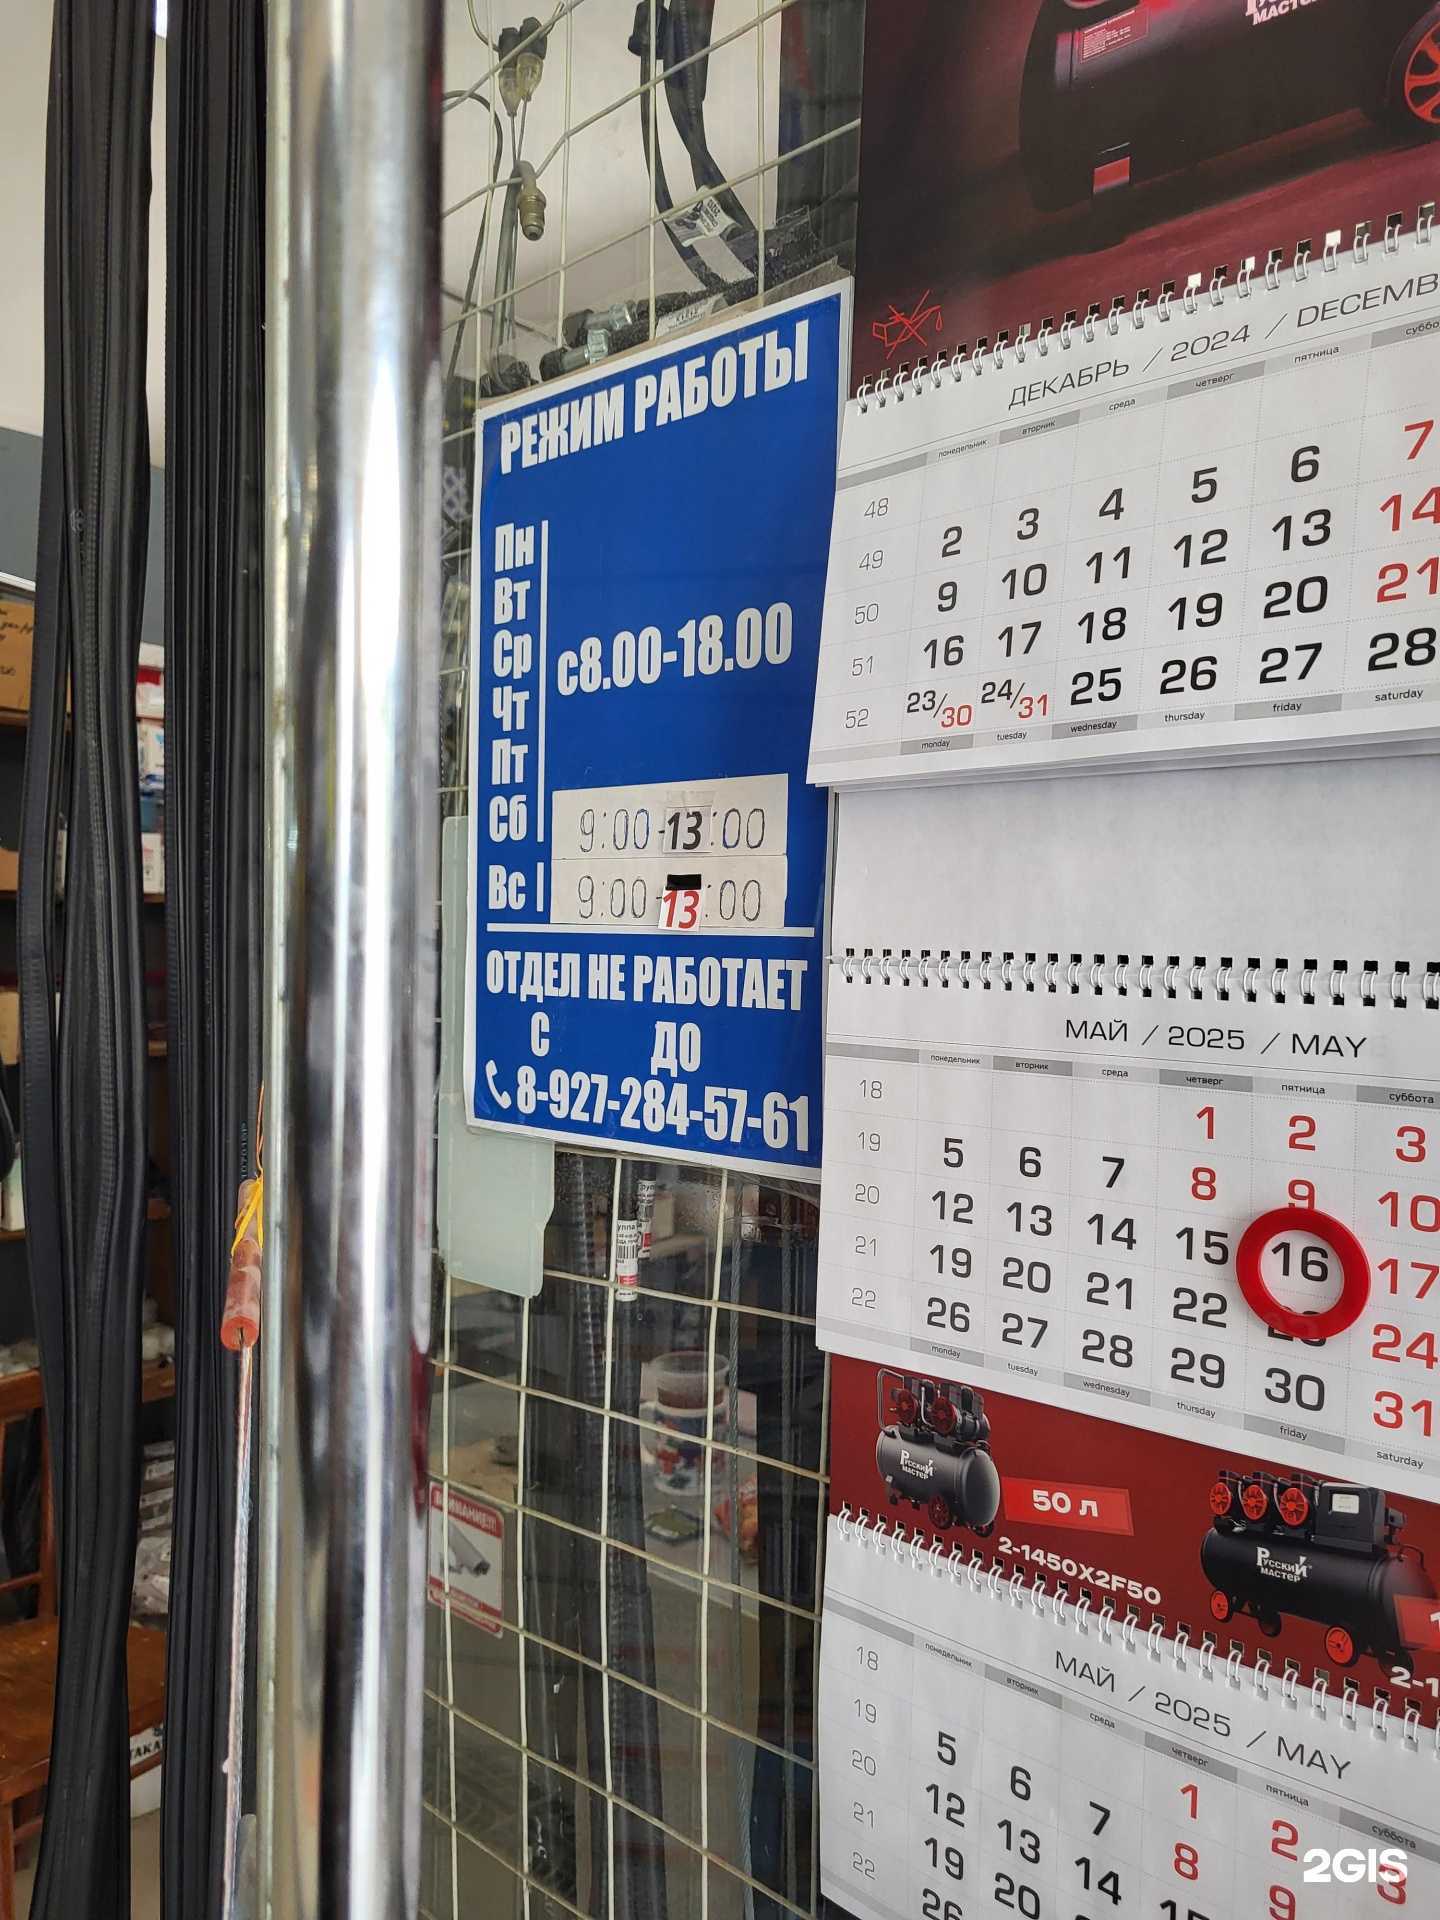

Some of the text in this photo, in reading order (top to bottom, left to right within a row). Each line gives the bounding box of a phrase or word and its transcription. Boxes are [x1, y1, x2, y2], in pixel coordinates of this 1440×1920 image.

[1007, 273, 1440, 411] ДЕКАБРЬ 2024 DECEMB
[501, 320, 808, 475] РЕЖИМ РАБОТЫ
[939, 440, 987, 458] понедельник
[1022, 420, 1055, 434] вторник
[1109, 399, 1135, 410] среда
[1196, 373, 1234, 387] четверг
[1295, 347, 1339, 363] пятница
[859, 420, 1433, 570] 49 2 3 4 5 6 7
[864, 498, 888, 518] 48
[495, 523, 534, 572] Пн
[855, 487, 1440, 624] 50 9 10 11 12 13 14
[494, 578, 530, 624] Вт
[852, 557, 1439, 676] 51 16 17 18 19 20 21
[494, 630, 531, 679] Ср
[558, 603, 792, 695] с8.00-18.00
[846, 628, 1436, 728] 52 23/30 24/31 25 26 27 28
[493, 686, 529, 731] Чт
[922, 690, 1423, 752] monday tuesday wednesday thursday friday saturday
[492, 739, 528, 785] Пт
[490, 795, 527, 842] Сб
[489, 865, 525, 909] Вс
[487, 950, 807, 1010] ОТДЕЛ НЕ РАБОТАЕТ
[531, 1012, 700, 1077] С ДО
[931, 1055, 980, 1064] понедельник
[1016, 1062, 1048, 1070] вторник
[1186, 1077, 1224, 1086] четверг
[1282, 1085, 1325, 1094] пятница
[1389, 1093, 1434, 1103] суббота
[1067, 1020, 1366, 1057] МАЙ 2025 MAY
[517, 1065, 809, 1151] 8-927-284-57-61
[860, 1080, 1425, 1162] 18 1 2 3
[859, 1132, 1440, 1232] 19 5 6 7 8 9 10
[855, 1184, 1439, 1298] 20 12 13 14 15 16 17
[856, 1236, 876, 1256] 21
[930, 1245, 971, 1278] 19
[1003, 1257, 1050, 1293] 20
[1087, 1272, 1132, 1310] 21
[1173, 1288, 1227, 1328] 22
[1372, 1324, 1438, 1369] 24
[852, 1288, 1432, 1436] 22 26 27 28 29 30 31
[932, 1346, 1423, 1469] monday tuesday wednesday thursday friday saturday
[1033, 1490, 1098, 1517] 50 л
[998, 1536, 1161, 1606] 2-1450X2F50
[857, 1647, 878, 1670] 18
[1181, 1784, 1197, 1819] 1
[1272, 1820, 1298, 1861] 2
[926, 1643, 1416, 1850] понедельник вторник среда четверг пятница суббота
[1056, 1651, 1350, 1779] МАЙ 2025 MAY
[852, 1750, 876, 1776] 20
[926, 1784, 964, 1827] 12
[998, 1820, 1040, 1864] 13
[1075, 1857, 1121, 1905] 14
[855, 1699, 1295, 1920] 19 5 6 7 8 9
[853, 1852, 875, 1880] 22
[854, 1802, 1040, 1920] 21 19 20
